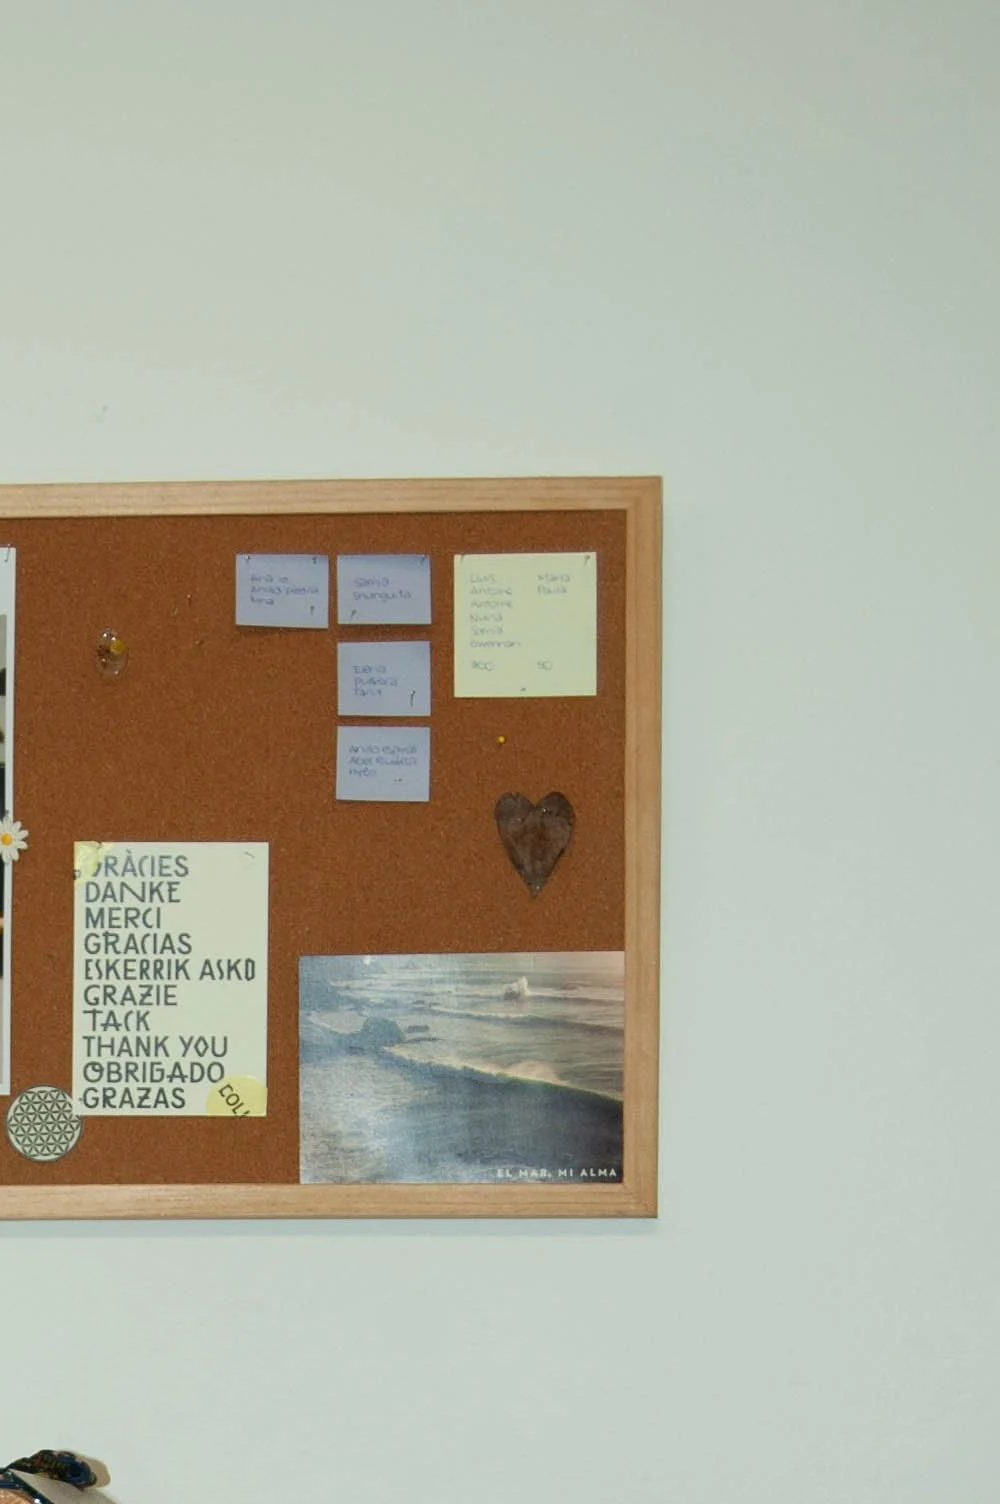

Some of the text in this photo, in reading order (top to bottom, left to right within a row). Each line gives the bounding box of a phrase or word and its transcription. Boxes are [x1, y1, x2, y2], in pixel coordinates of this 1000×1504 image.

[85, 881, 181, 903] DANKE
[85, 906, 161, 929] MERCI
[84, 931, 192, 955] GRACIAS
[85, 957, 256, 981] ESKERRIK ASKO
[84, 984, 178, 1006] GRAZIE
[83, 1008, 150, 1031] TACK
[83, 1035, 228, 1058] THANK YOU
[83, 1061, 225, 1083] OBRIGADO
[82, 1087, 186, 1109] GRAZAS
[497, 1168, 512, 1177] EL
[558, 1168, 573, 1177] MI
[580, 1168, 617, 1177] ALMA
